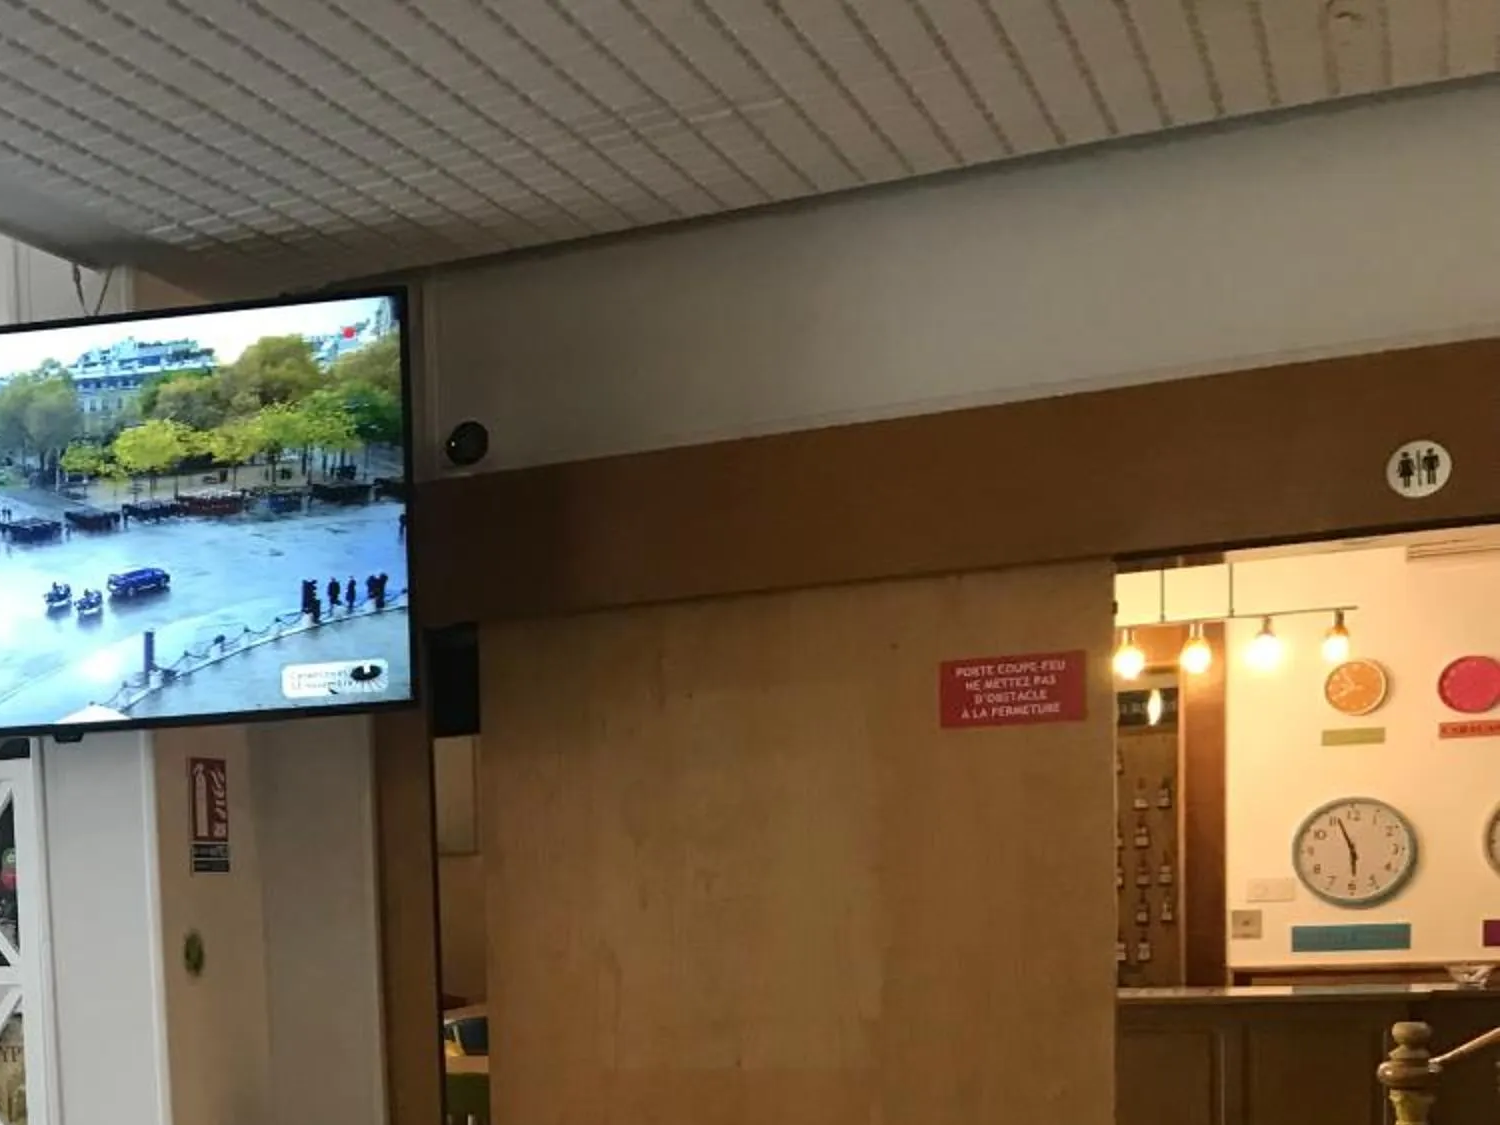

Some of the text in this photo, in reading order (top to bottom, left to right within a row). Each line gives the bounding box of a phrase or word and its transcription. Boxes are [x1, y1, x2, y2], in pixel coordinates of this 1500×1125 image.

[955, 659, 1066, 678] PORTE COUPE-FEU
[965, 674, 1057, 691] NE METTEZ PAS
[972, 706, 989, 719] LA
[991, 702, 1061, 718] FERMETURE
[1314, 829, 1327, 840] 10
